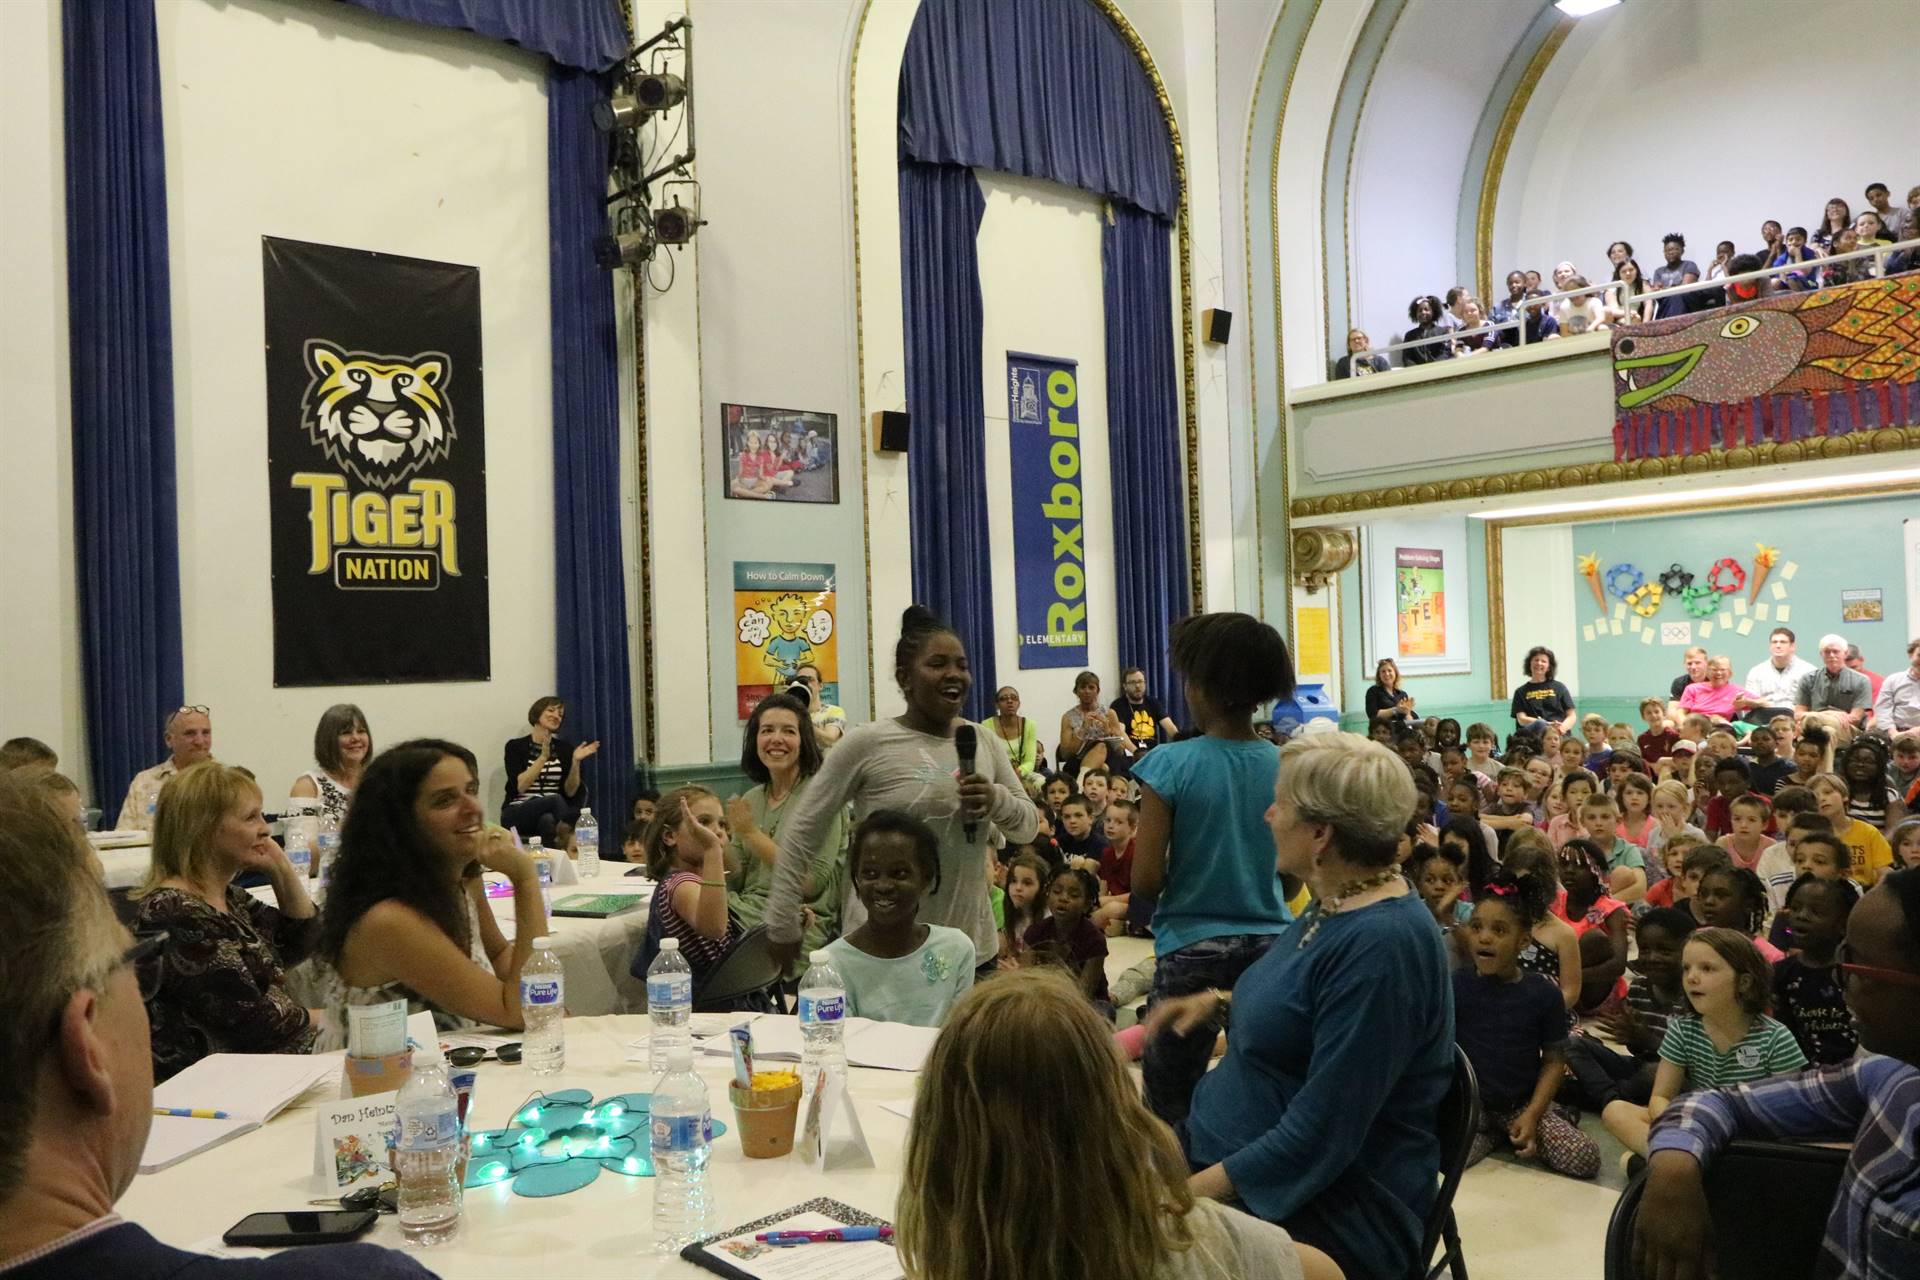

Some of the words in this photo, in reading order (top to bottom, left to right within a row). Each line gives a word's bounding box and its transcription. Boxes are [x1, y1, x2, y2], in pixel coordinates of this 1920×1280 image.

[1011, 367, 1020, 402] Heights
[1041, 370, 1086, 647] Roxboro
[291, 471, 462, 577] TIGER
[345, 558, 429, 580] NATION
[746, 571, 766, 580] How
[768, 572, 778, 581] to
[779, 571, 799, 581] Calm
[800, 572, 825, 581] Down
[743, 618, 764, 627] can
[1026, 634, 1084, 645] ELEMENTARY
[530, 988, 546, 997] Pure
[546, 987, 558, 998] Life
[330, 1112, 355, 1125] Dan
[358, 1104, 396, 1122] Heintz
